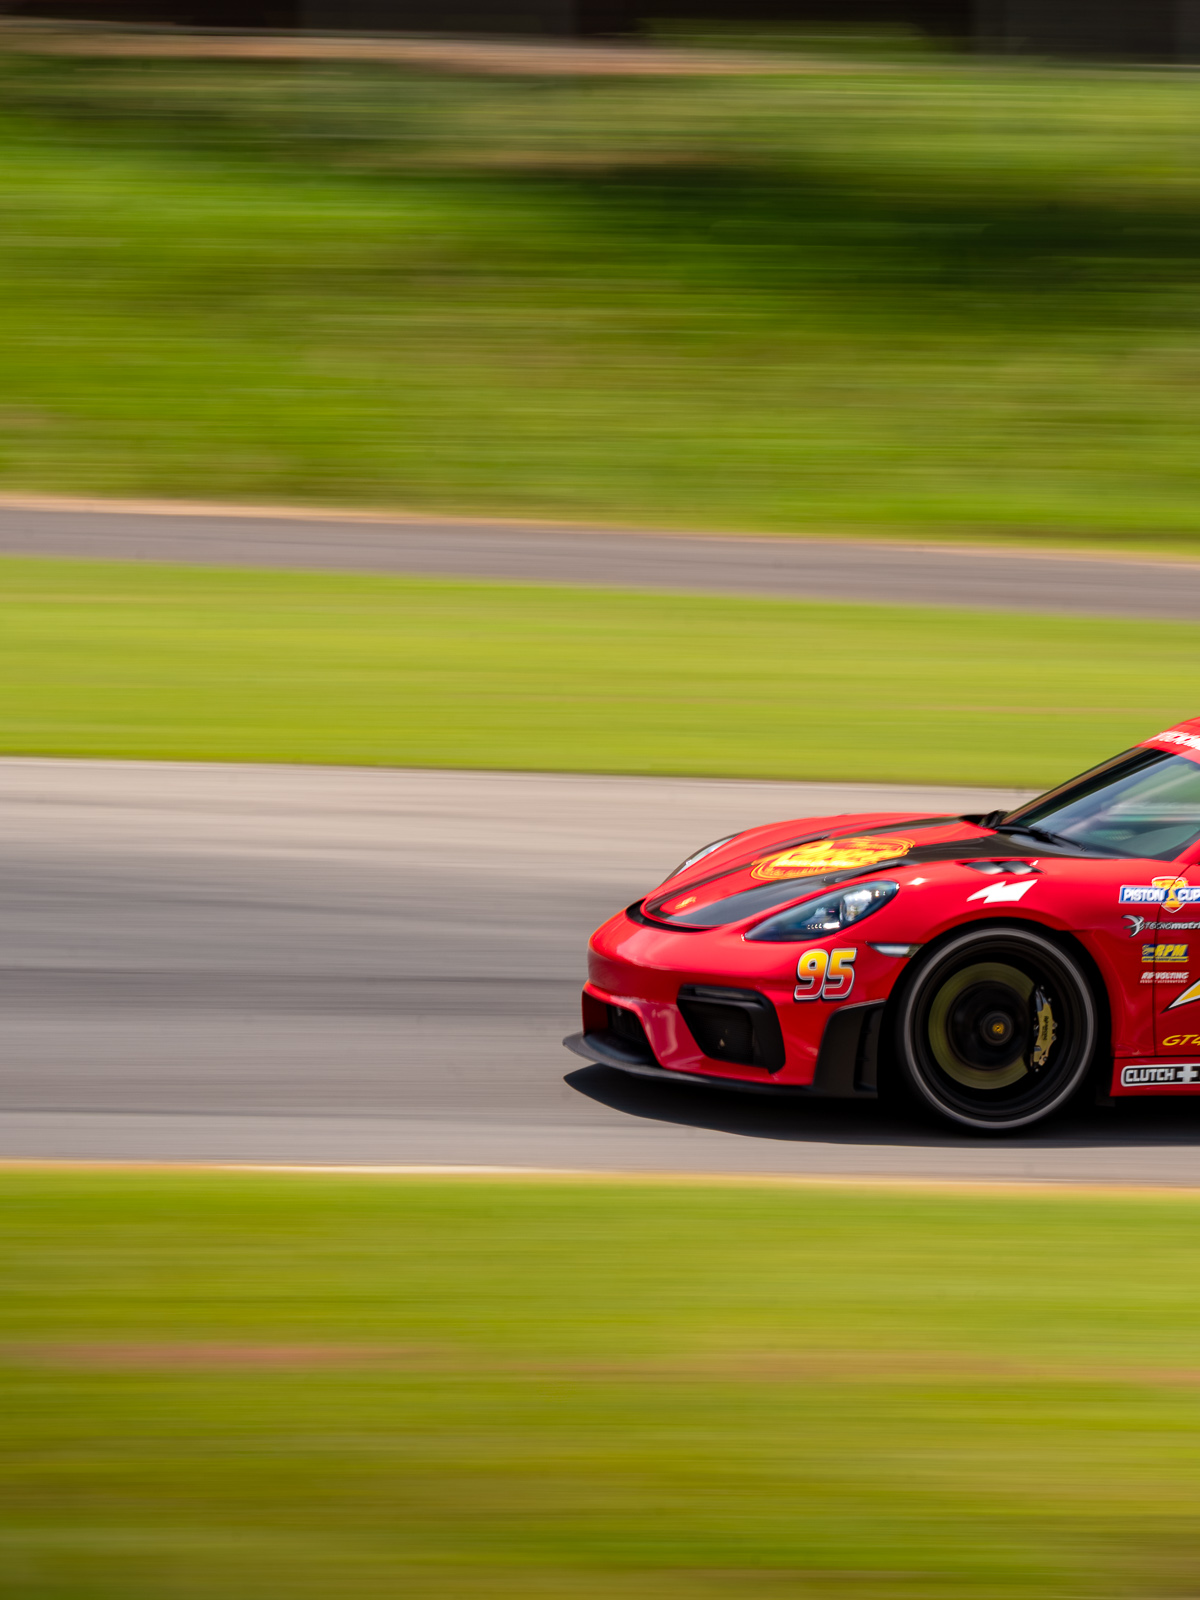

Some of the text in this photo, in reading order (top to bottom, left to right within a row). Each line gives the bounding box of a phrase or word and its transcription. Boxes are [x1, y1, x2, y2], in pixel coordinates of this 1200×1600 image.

[1123, 888, 1163, 901] PISTON
[1155, 944, 1189, 957] RPM
[793, 947, 858, 1002] 95
[1125, 1068, 1176, 1083] CLUTCH
